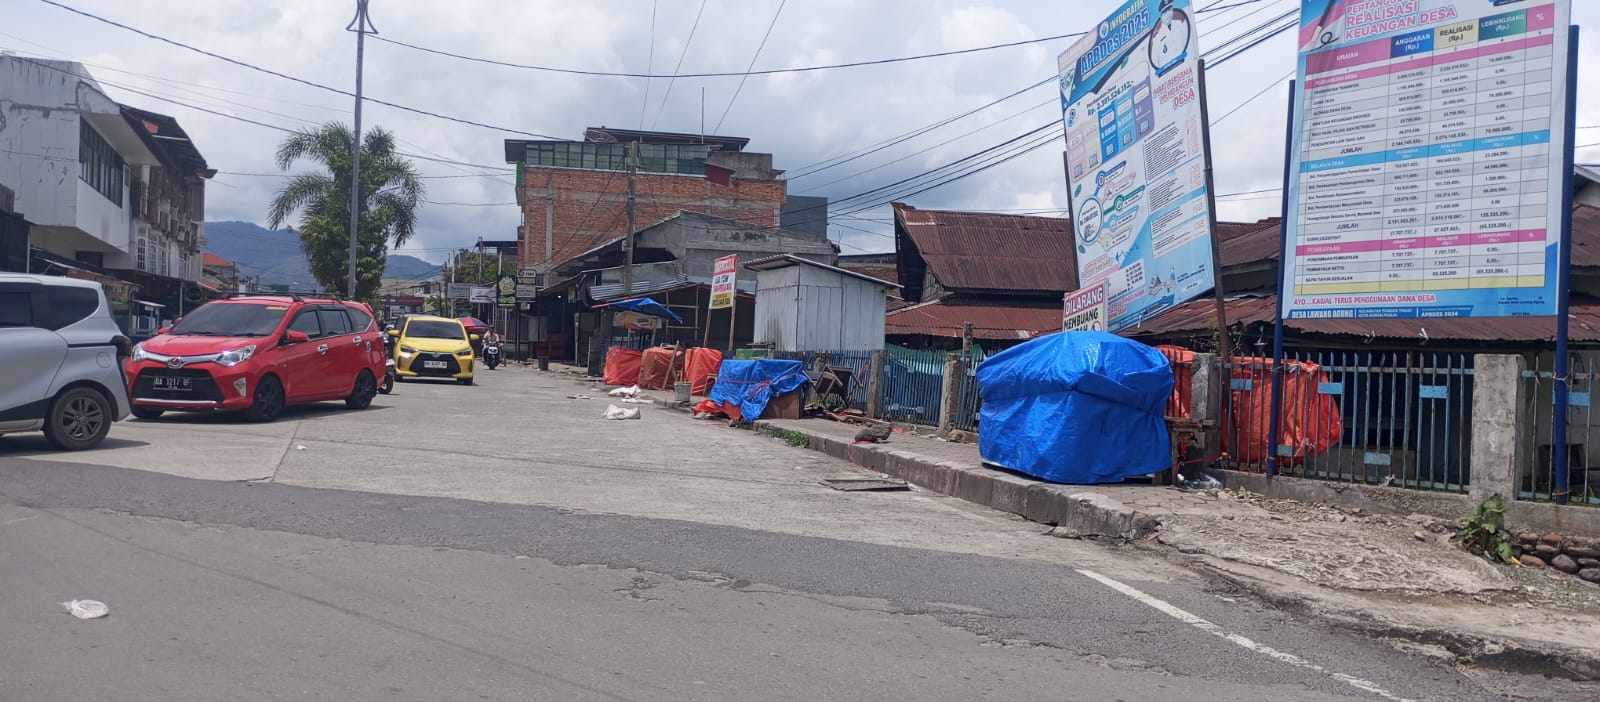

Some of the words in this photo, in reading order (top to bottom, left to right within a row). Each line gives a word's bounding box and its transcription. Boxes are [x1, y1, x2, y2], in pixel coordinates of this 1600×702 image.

[1108, 1, 1145, 31] INFOGRAFIK
[1345, 16, 1417, 41] KEUANGAN
[1419, 7, 1457, 24] DESA
[1346, 1, 1418, 27] REALISASI
[1439, 24, 1474, 37] REALISASI
[1080, 33, 1120, 76] APBDes
[1120, 8, 1151, 45] 2025
[1168, 67, 1193, 86] BERSAMA
[1173, 88, 1195, 107] DESA
[1340, 146, 1363, 154] JUMLAH
[1065, 286, 1103, 315] DILARANG
[1354, 295, 1396, 304] PENGGUNAAN
[1417, 294, 1435, 302] DESA
[1063, 307, 1099, 330] MEMBUANG
[1292, 310, 1306, 318] DESA
[1307, 310, 1331, 318] LAWANG
[1332, 310, 1354, 318] AGUNG
